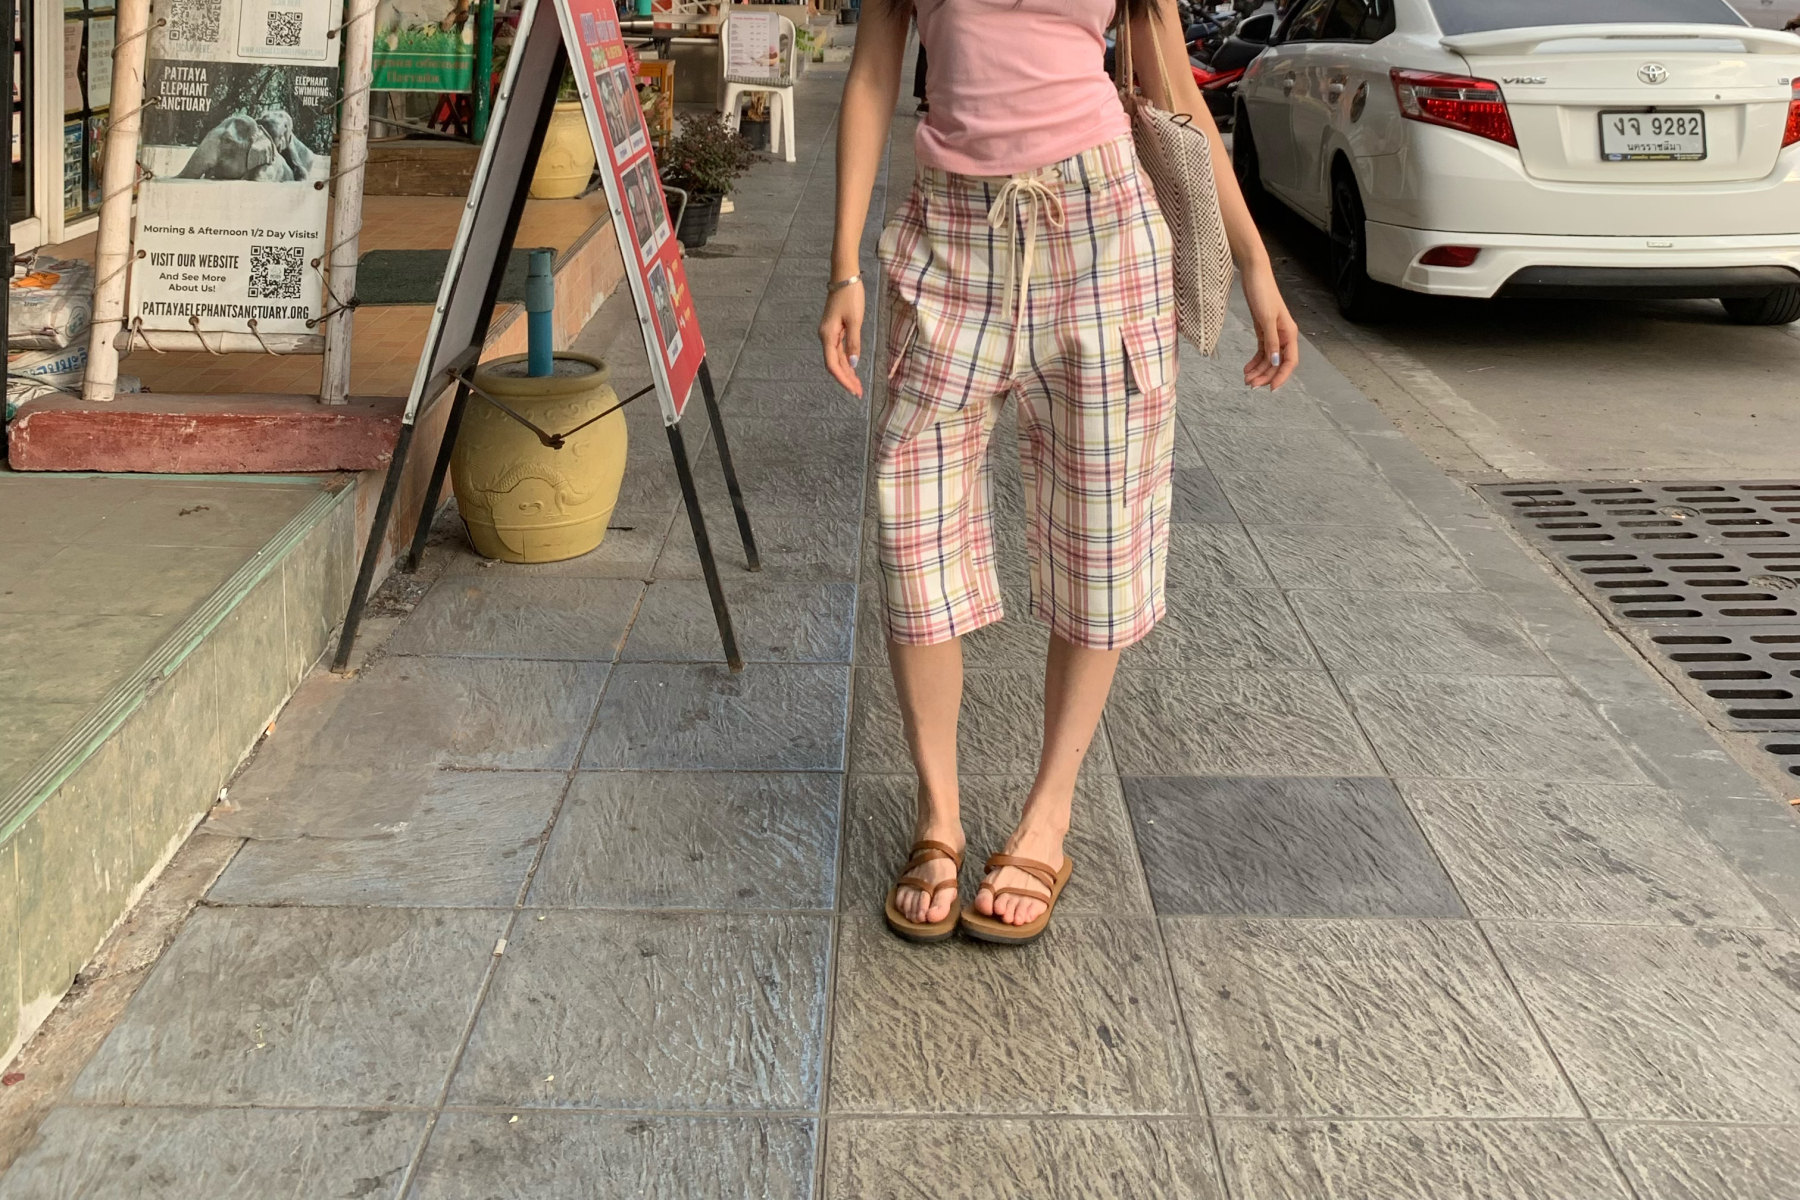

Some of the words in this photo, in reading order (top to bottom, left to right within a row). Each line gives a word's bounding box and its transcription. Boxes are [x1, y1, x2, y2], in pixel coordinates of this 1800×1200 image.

[164, 66, 207, 82] PATTAYA
[1501, 76, 1547, 85] VIOS
[295, 76, 328, 87] ELEPHANT
[160, 81, 209, 97] ELEPHANT
[294, 87, 329, 97] SWIMMING
[155, 96, 212, 112] SANCTUARY
[302, 96, 319, 107] HOLE
[1651, 117, 1699, 136] 9282
[1627, 140, 1681, 151] นครราชสีมา
[143, 225, 185, 235] Morning
[188, 226, 195, 235] &
[197, 227, 248, 236] Afternoon
[251, 228, 264, 237] 1/2
[266, 229, 286, 240] Day
[288, 229, 318, 239] Visits!
[150, 252, 176, 267] VISIT
[177, 253, 196, 268] OUR
[198, 254, 239, 270] WEBSITE
[159, 272, 179, 281] And
[181, 272, 199, 281] See
[201, 273, 226, 282] More
[168, 283, 198, 292] About
[201, 284, 216, 293] Us!
[142, 301, 309, 320] PATTAYAELEPHANTSANCTUARY.ORG
